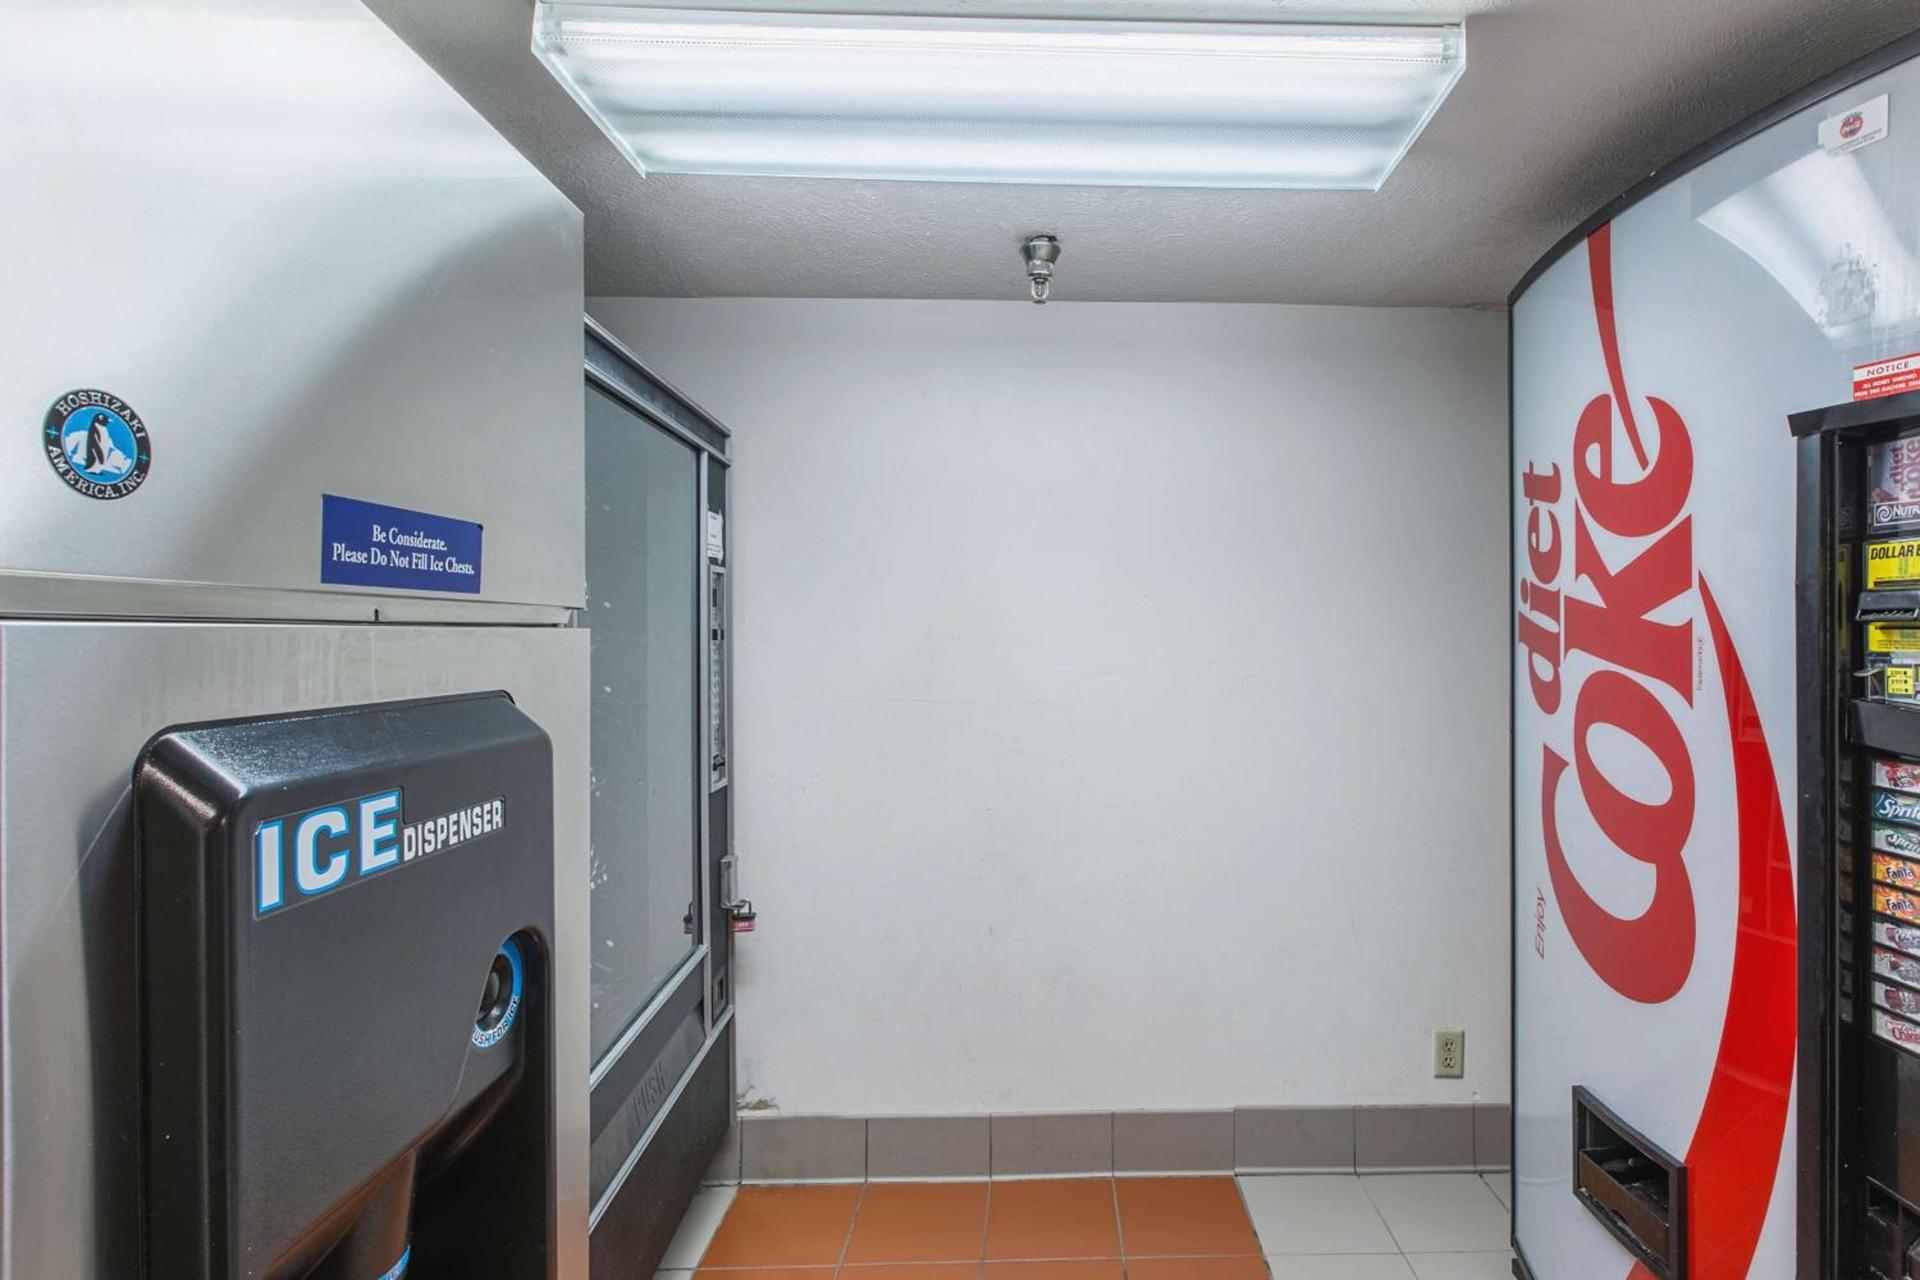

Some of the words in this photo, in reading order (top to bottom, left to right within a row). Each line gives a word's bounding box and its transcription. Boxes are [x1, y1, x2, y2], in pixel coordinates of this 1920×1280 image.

[1867, 359, 1909, 377] NOTICE
[55, 391, 146, 438] HOSHIZAKI
[372, 524, 387, 543] Be
[388, 527, 448, 551] Considerate.
[332, 543, 368, 564] Please
[370, 547, 388, 566] Do
[389, 549, 410, 568] Not
[411, 552, 428, 570] Fill
[429, 555, 444, 572] Ice
[445, 556, 475, 575] Chests.
[1871, 543, 1914, 560] DOLLAR
[1518, 460, 1562, 716] diet
[1542, 392, 1697, 1005] Coke
[258, 789, 401, 914] ICE
[403, 798, 504, 862] DISPENSER
[1886, 867, 1915, 881] Fanta
[1886, 901, 1915, 914] Fanta
[1534, 886, 1546, 960] Enjoy
[492, 1020, 508, 1042] FOR
